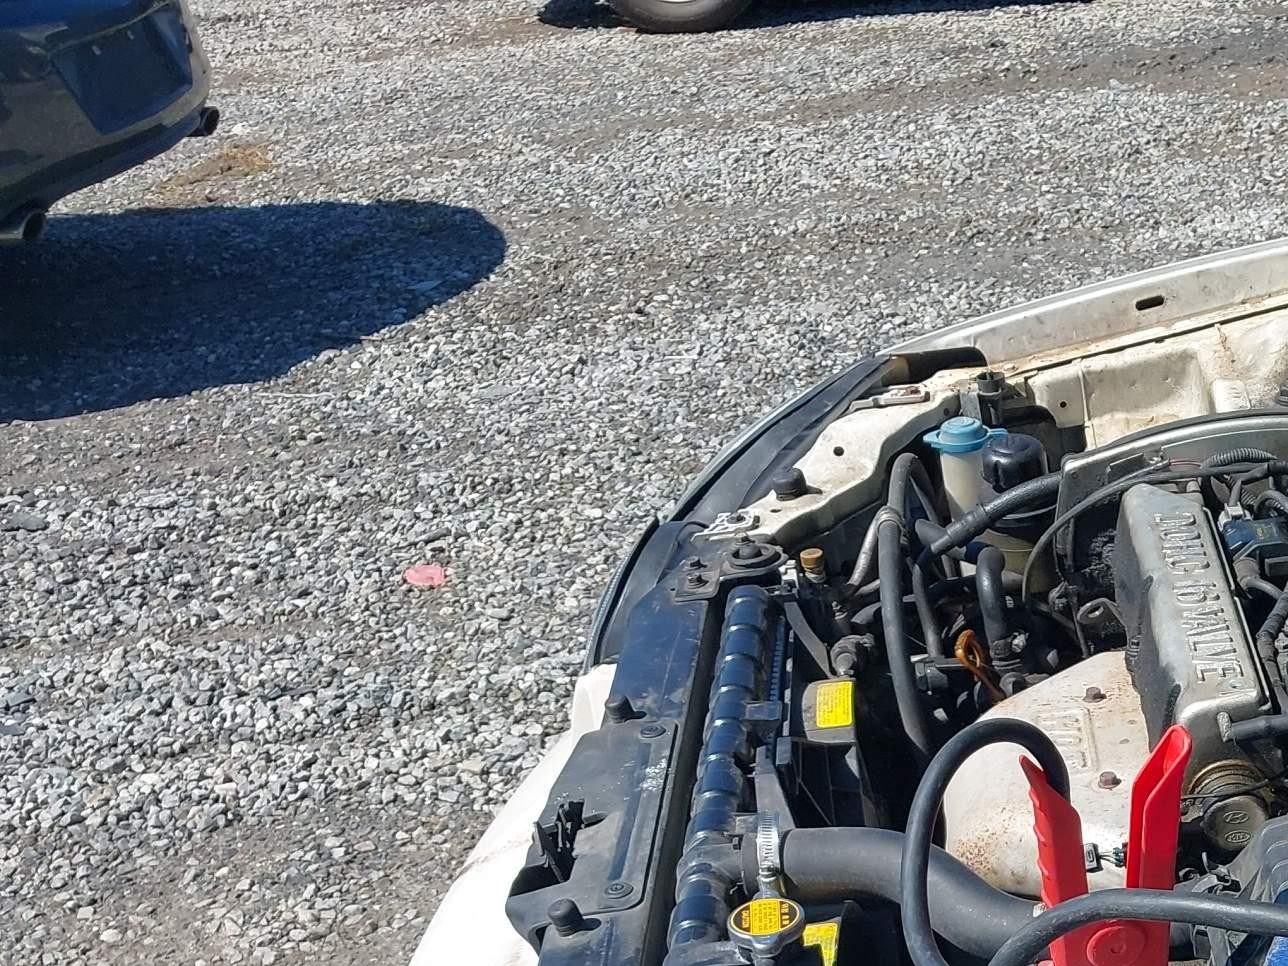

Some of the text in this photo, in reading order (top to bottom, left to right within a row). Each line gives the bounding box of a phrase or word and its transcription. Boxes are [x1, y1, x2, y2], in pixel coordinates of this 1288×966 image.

[1154, 512, 1244, 682] DOHC 16 VALVE
